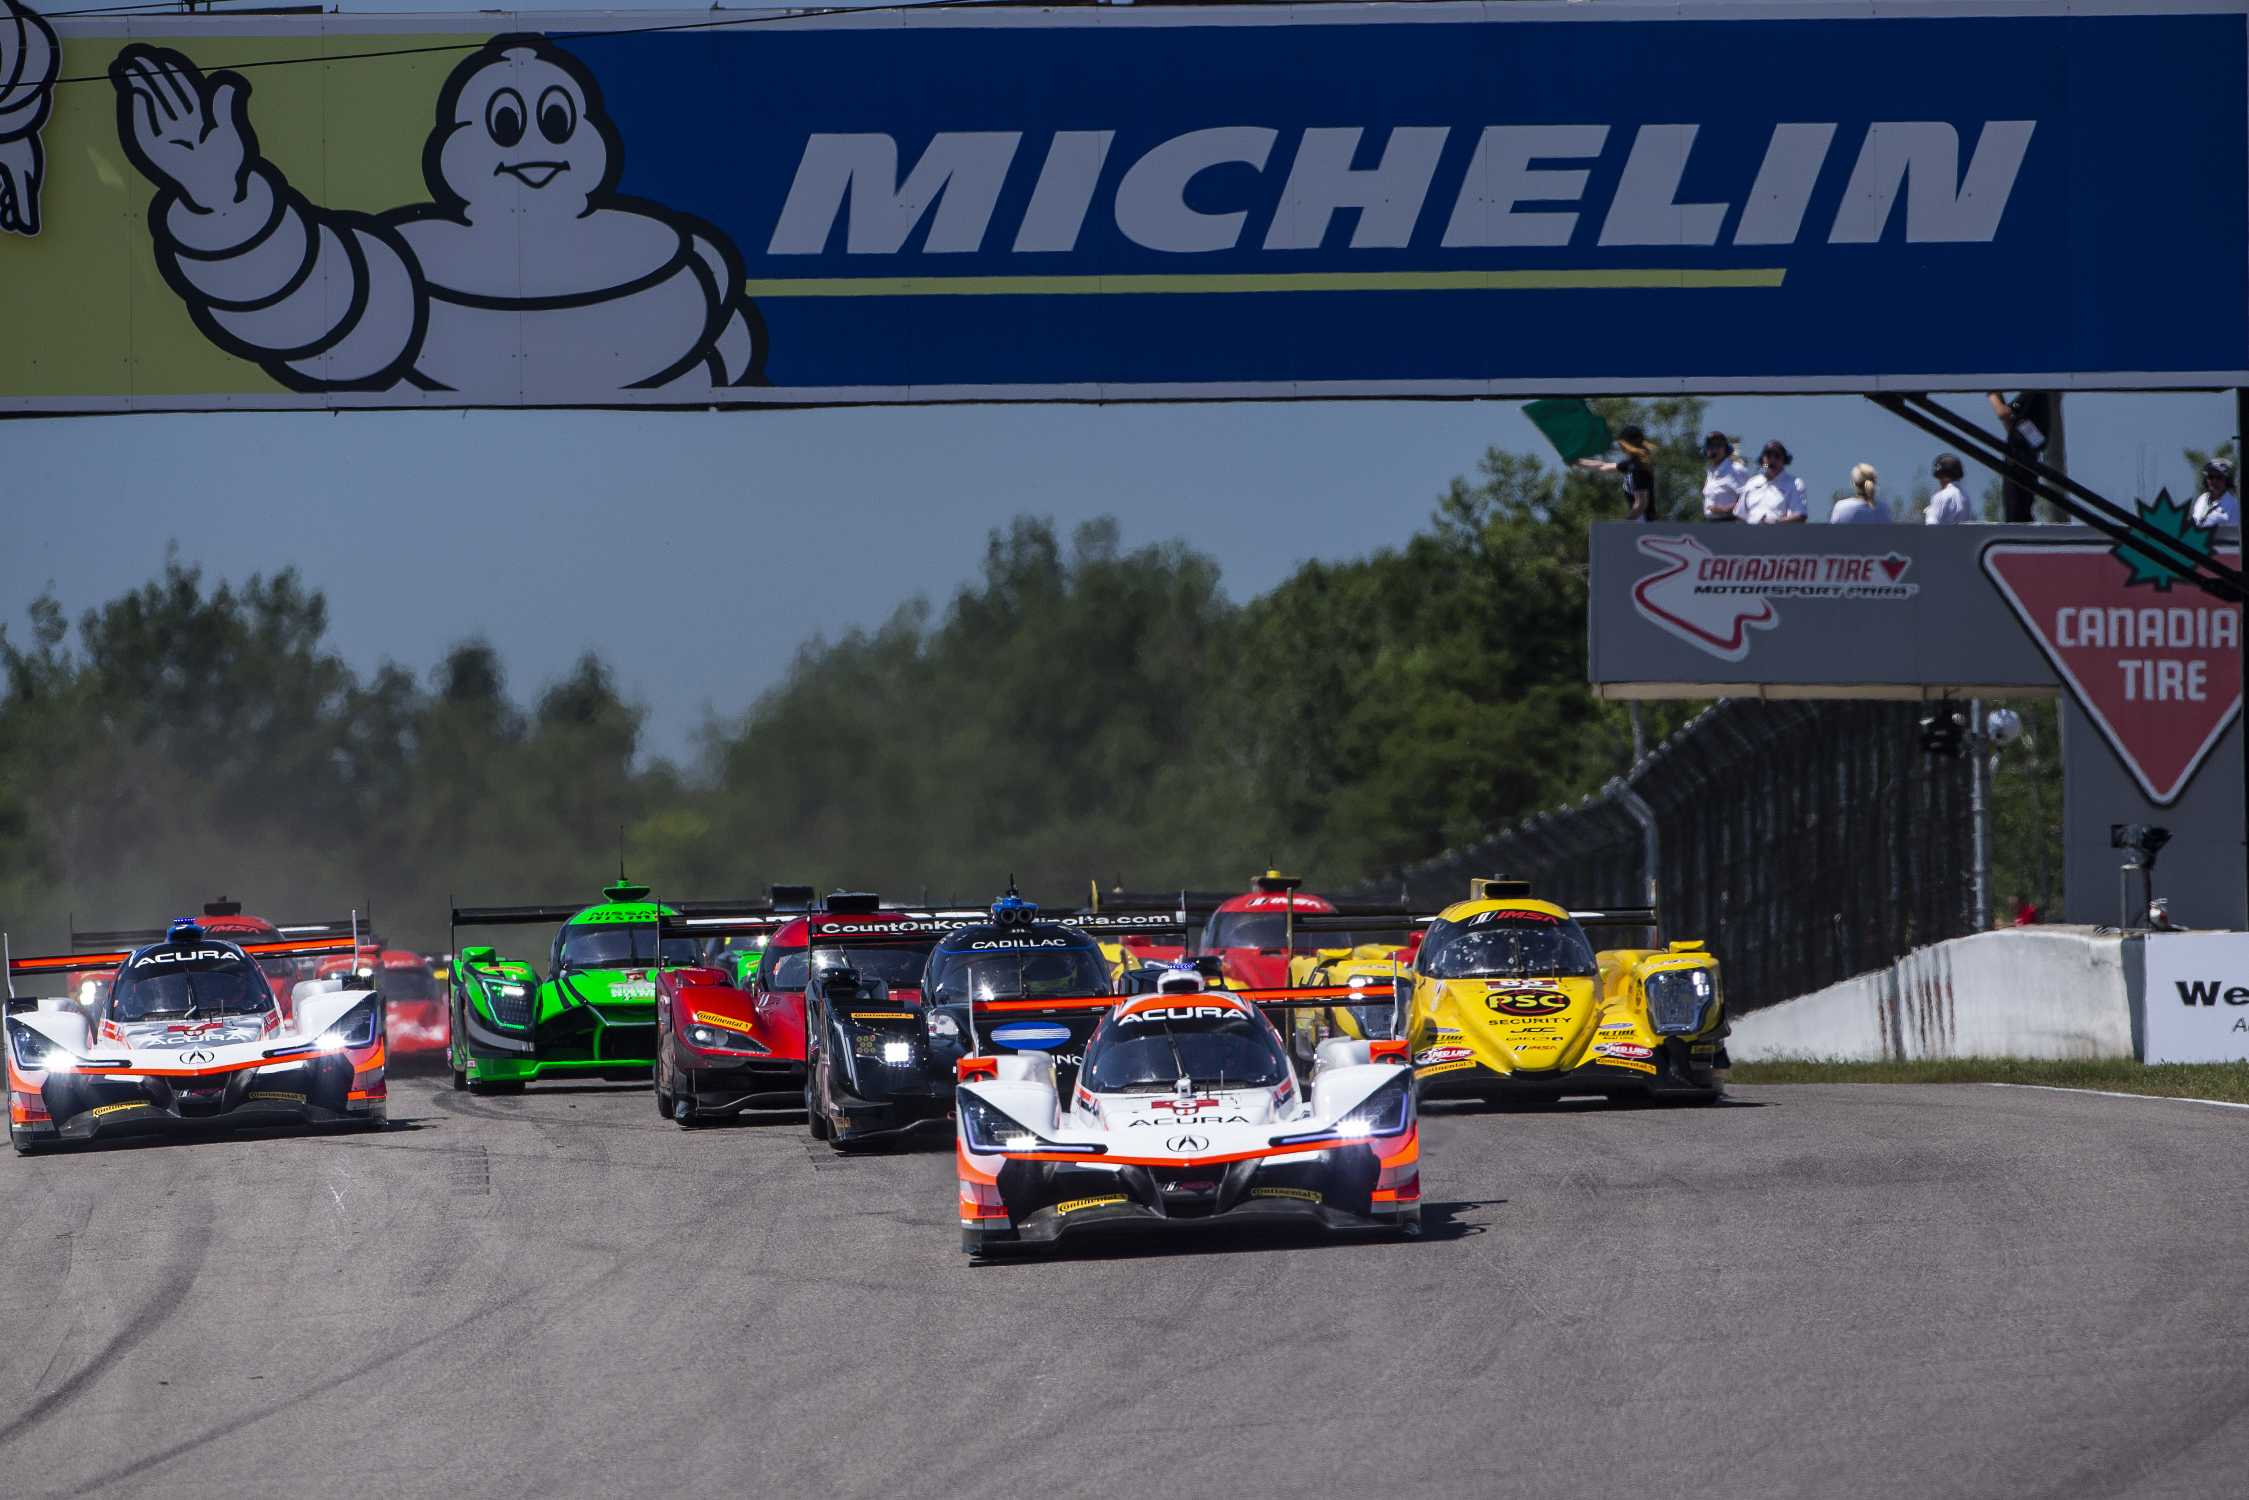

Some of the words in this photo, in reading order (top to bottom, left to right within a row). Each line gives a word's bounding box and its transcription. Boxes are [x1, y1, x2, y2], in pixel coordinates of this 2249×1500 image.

[767, 120, 2036, 256] MICHELIN
[1698, 557, 1817, 581] CANADIAN
[1825, 557, 1874, 581] TIRE
[1694, 585, 1843, 596] MOTORSPORT
[2056, 607, 2238, 648] CANADIA
[2118, 660, 2207, 701] TIRE
[1497, 910, 1559, 926] IMSA
[971, 938, 1067, 950] CADILLAC
[134, 950, 241, 968] ACURA
[1488, 994, 1567, 1009] PSC
[1118, 1006, 1249, 1026] ACURA
[1488, 1017, 1572, 1026] SECURITY
[147, 1030, 248, 1046] ACURA
[1127, 1115, 1250, 1128] ACURA
